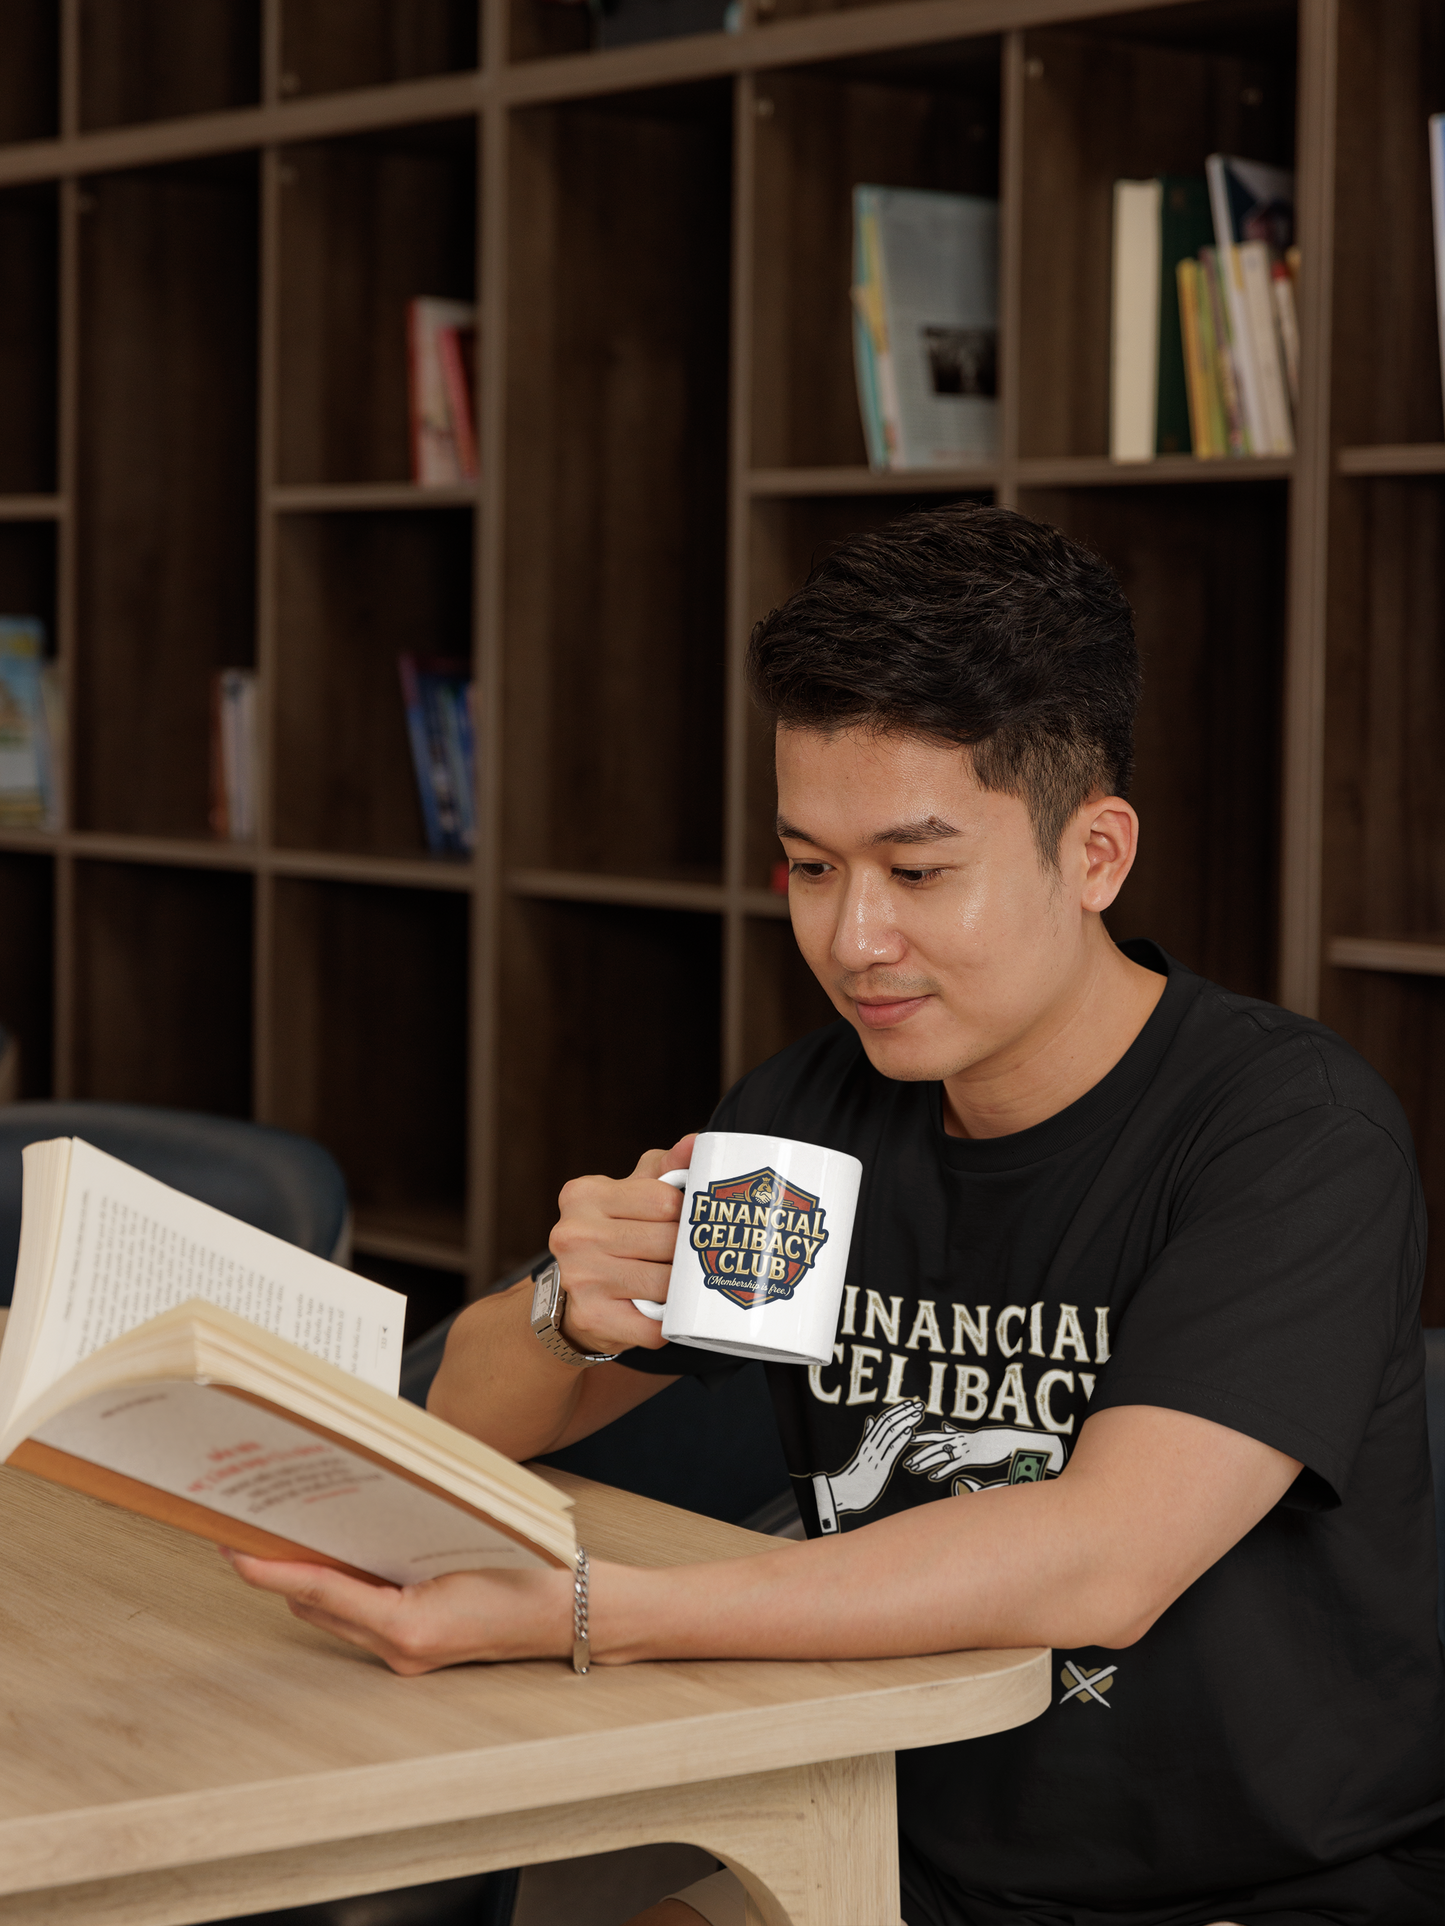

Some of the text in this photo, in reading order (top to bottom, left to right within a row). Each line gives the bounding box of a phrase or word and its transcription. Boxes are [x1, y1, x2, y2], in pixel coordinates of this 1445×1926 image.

[692, 1195, 826, 1240] FINANCIAL
[692, 1224, 821, 1265] CELIBACY
[718, 1250, 786, 1280] CLUB
[707, 1275, 791, 1296] (Membership is free.)
[840, 1285, 1111, 1364] INANCIAL
[807, 1344, 1097, 1435] CELIBAC
